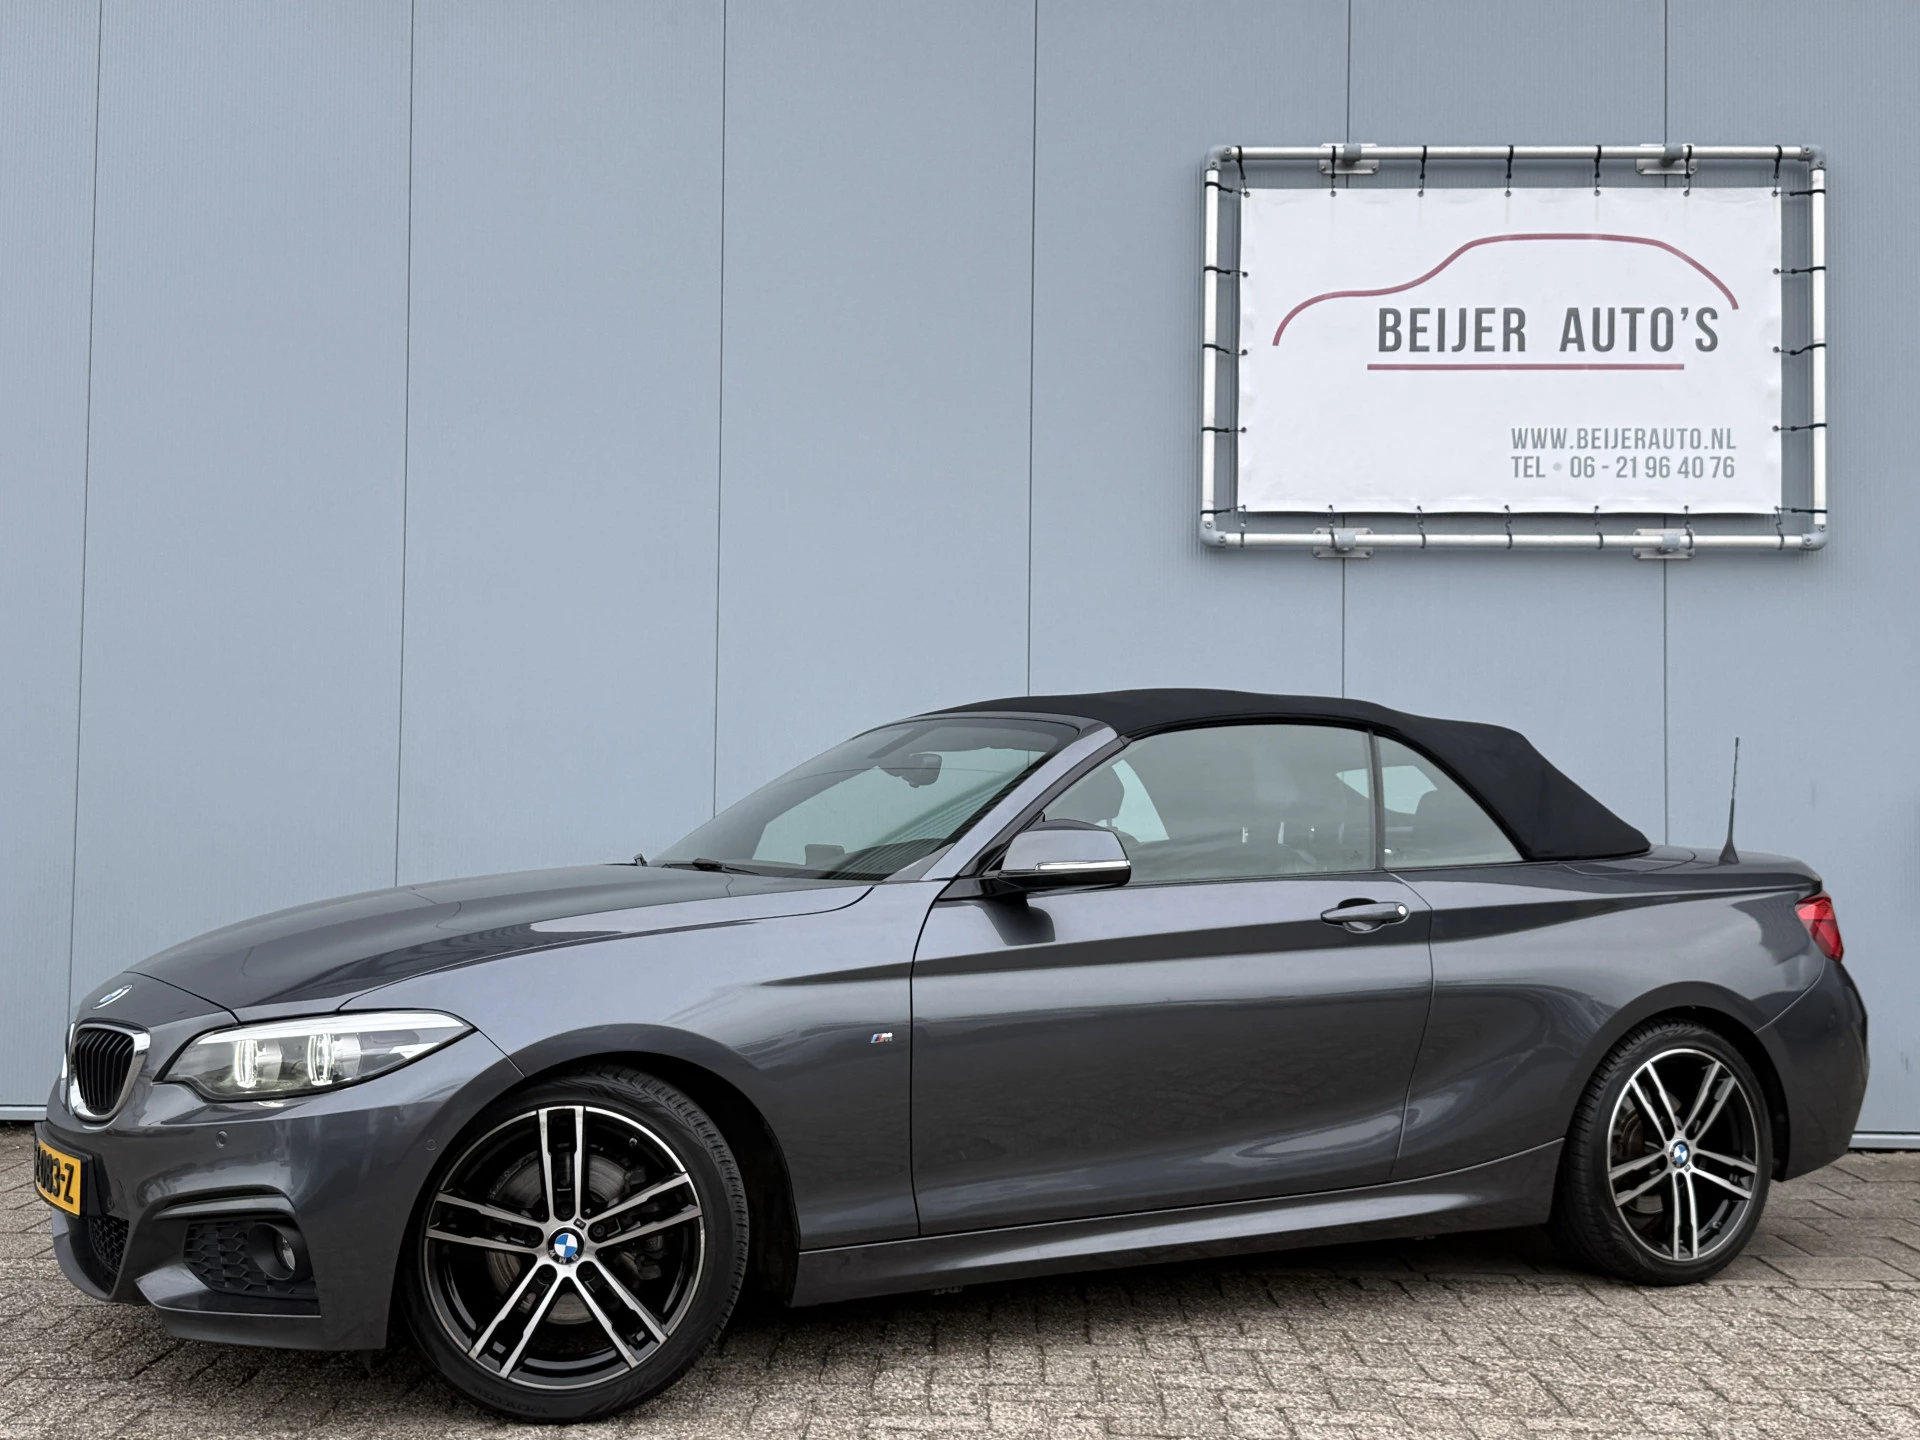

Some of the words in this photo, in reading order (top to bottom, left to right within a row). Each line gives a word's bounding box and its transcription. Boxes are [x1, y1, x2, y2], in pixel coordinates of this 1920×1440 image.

[1378, 307, 1526, 353] BEIJER
[1558, 306, 1719, 353] AUTO'S
[1511, 427, 1737, 450] WWW.BEIJERAUTO.NL
[1510, 455, 1547, 479] TEL
[1569, 455, 1596, 479] 06
[36, 1146, 75, 1205] 083-Z
